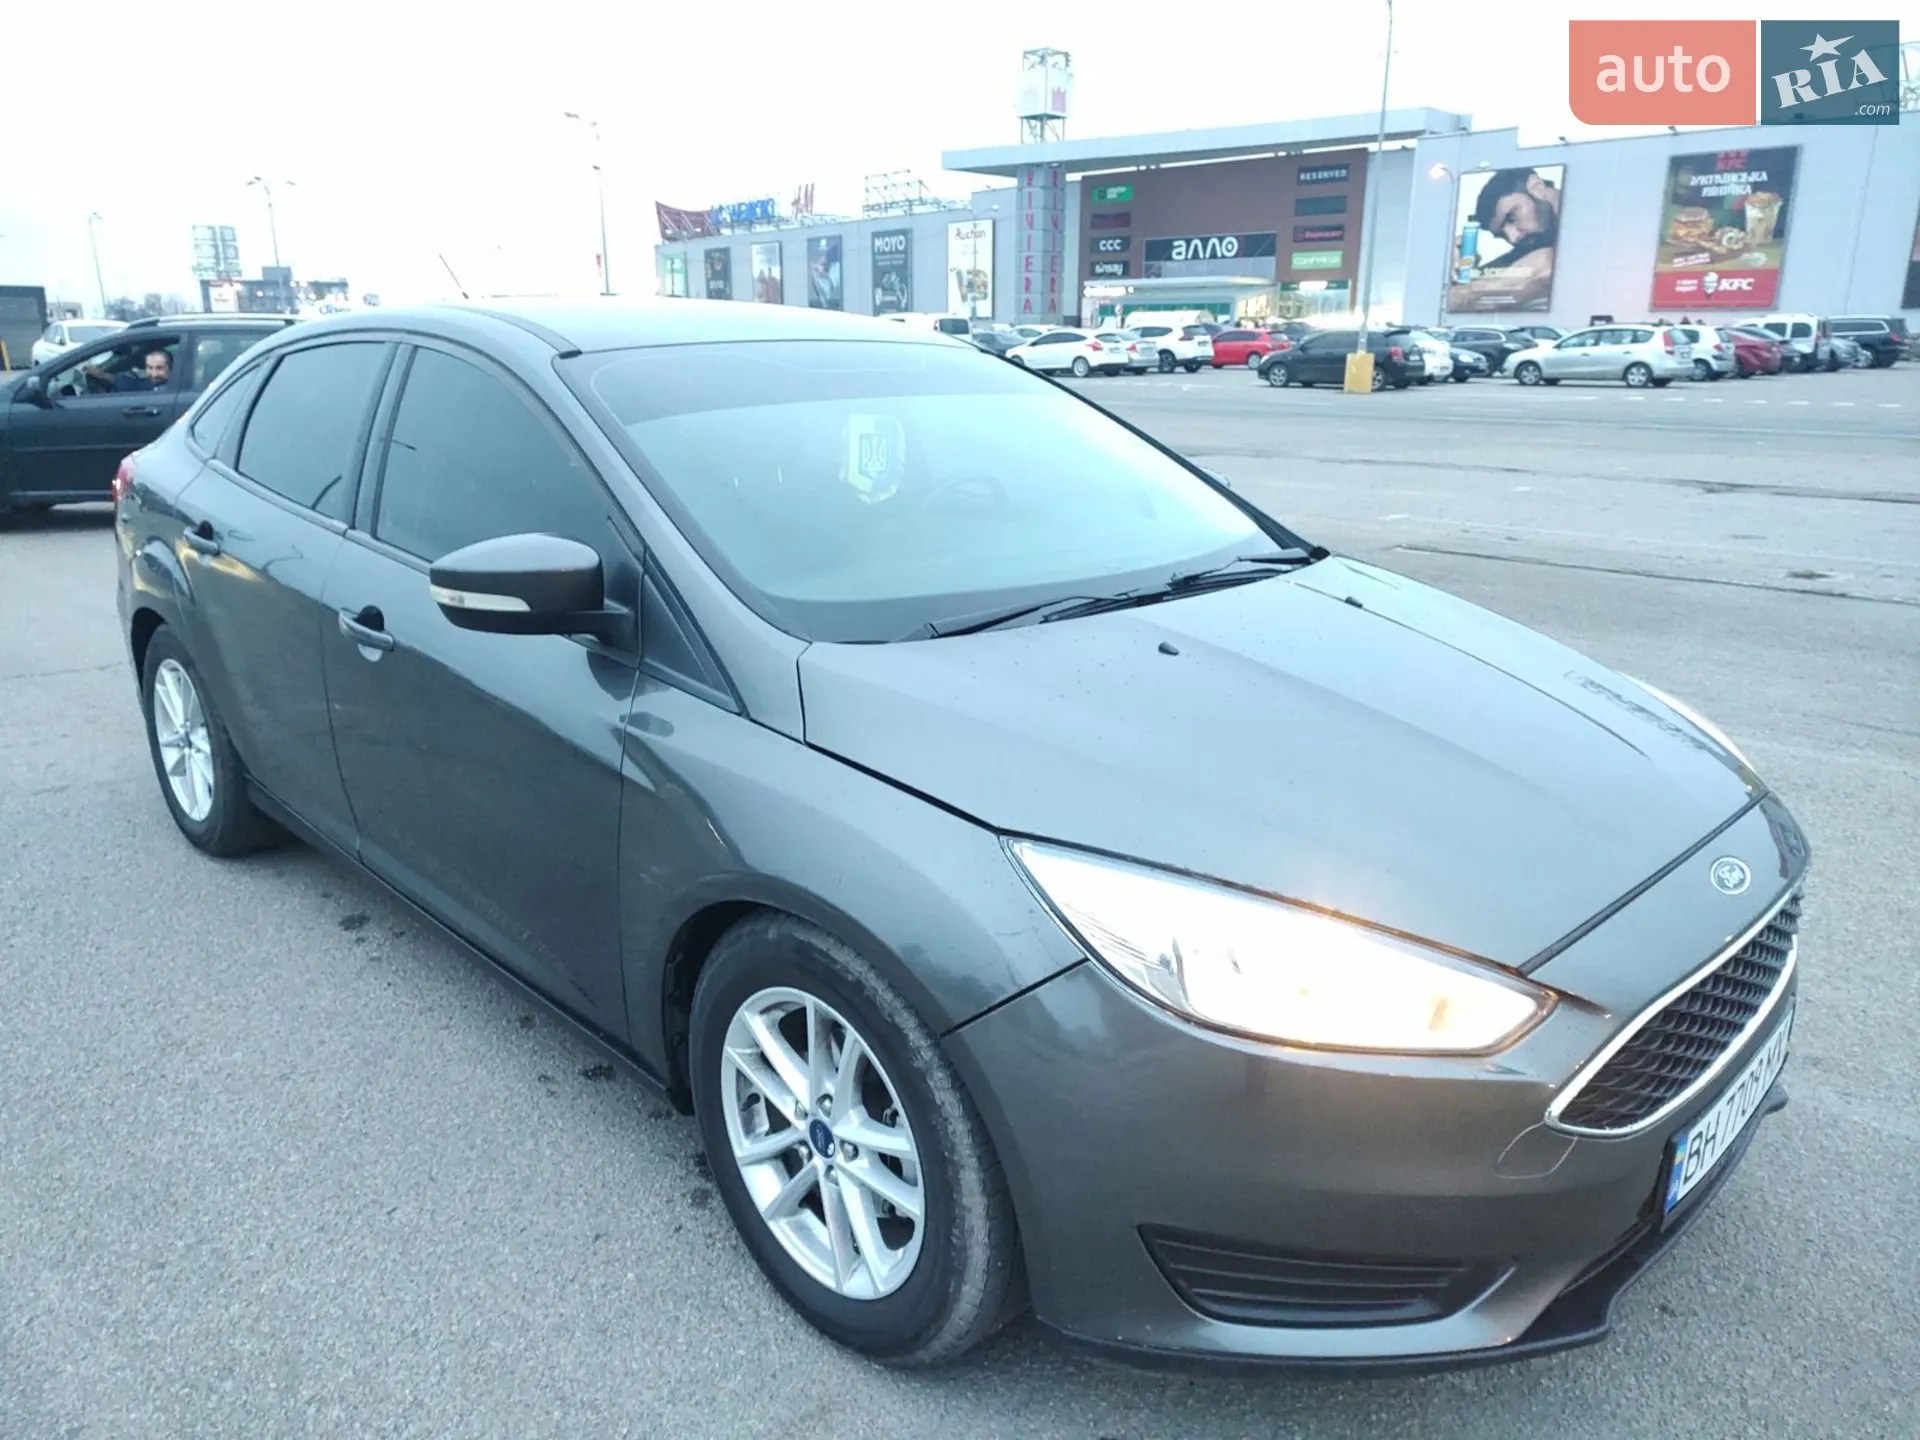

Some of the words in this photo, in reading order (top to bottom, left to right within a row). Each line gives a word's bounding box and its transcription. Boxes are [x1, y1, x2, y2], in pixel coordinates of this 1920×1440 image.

[1300, 169, 1348, 181] RESERVED
[955, 227, 986, 240] Auchan
[874, 235, 906, 253] MOYO
[1023, 170, 1035, 315] RIVIERA
[1049, 169, 1060, 315] RIVIERA
[1099, 239, 1122, 251] CCC
[1719, 278, 1755, 291] KFC
[1682, 1109, 1722, 1186] BH
